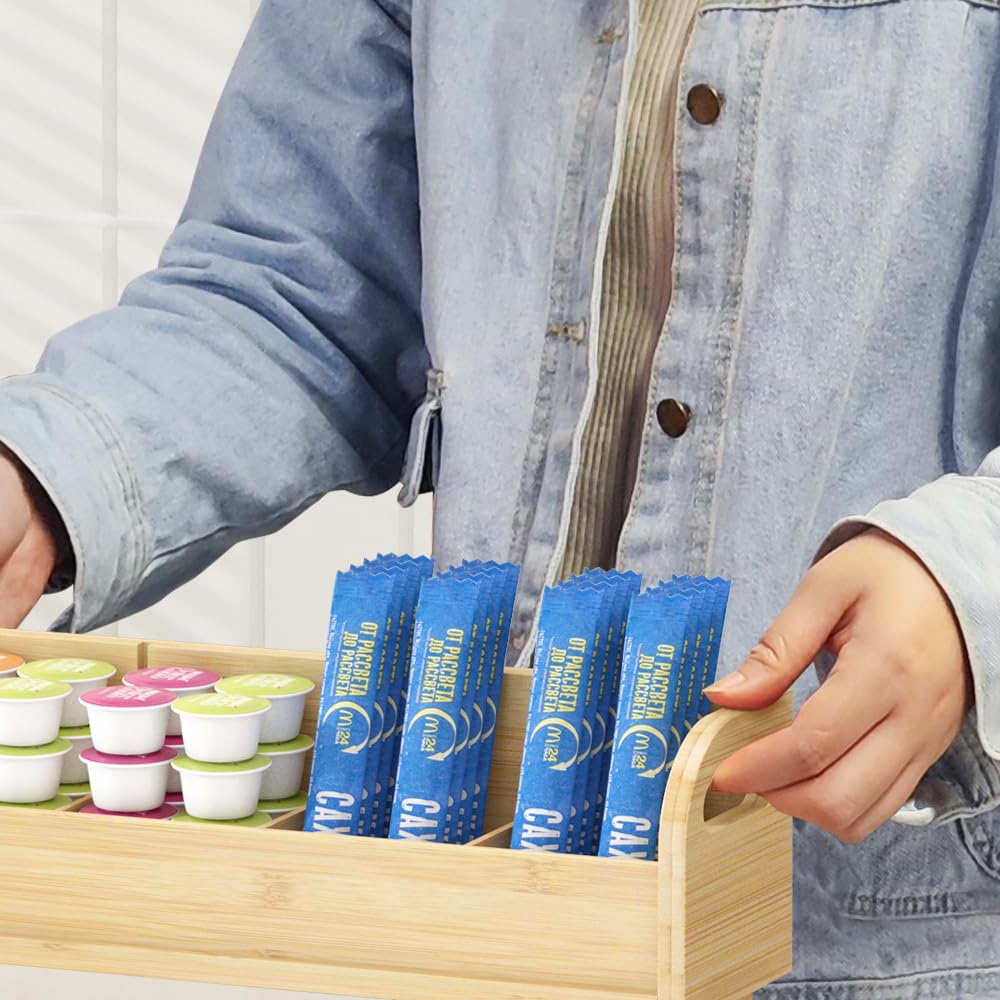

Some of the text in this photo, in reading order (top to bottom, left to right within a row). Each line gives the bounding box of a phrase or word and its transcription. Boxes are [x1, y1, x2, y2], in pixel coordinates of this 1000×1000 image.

[343, 631, 358, 646] ДО
[429, 638, 444, 654] ДО
[349, 622, 378, 696] ОТ РАССВЕТА
[435, 628, 464, 702] ОТ РАССВЕТА
[551, 648, 566, 663] ДО
[639, 654, 655, 670] ДО
[335, 650, 355, 696] РАССВЕТА
[421, 656, 440, 703] РАССВЕТА
[557, 637, 586, 712] ОТ РАССВЕТА
[645, 644, 675, 719] ОТ РАССВЕТА
[543, 666, 563, 712] РАССВЕТА
[631, 672, 651, 720] РАССВЕТА
[339, 730, 350, 745] 24
[425, 737, 436, 752] 24
[548, 747, 559, 762] 24
[635, 755, 647, 769] 24
